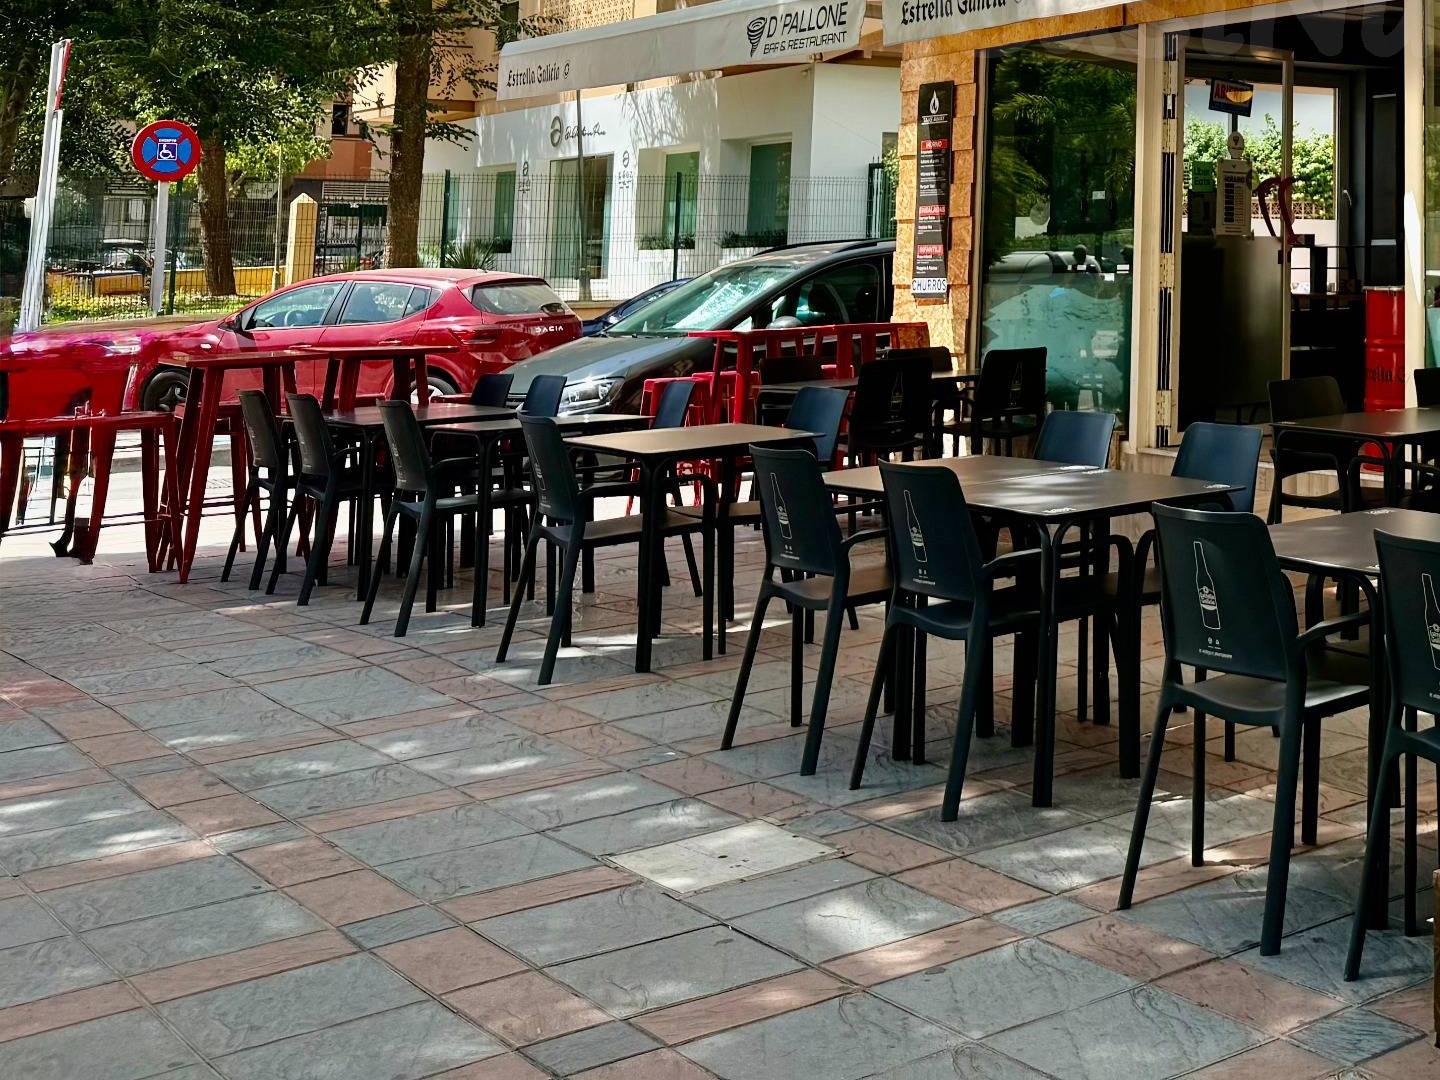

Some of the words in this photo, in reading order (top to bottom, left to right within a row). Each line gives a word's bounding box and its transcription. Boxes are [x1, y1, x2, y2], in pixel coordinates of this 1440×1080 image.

[763, 40, 779, 55] BAR
[788, 31, 848, 50] RESTAURANT
[506, 67, 536, 87] Estrella
[537, 62, 560, 84] Galicia
[912, 279, 947, 291] CHURROS
[535, 325, 564, 333] DACIA
